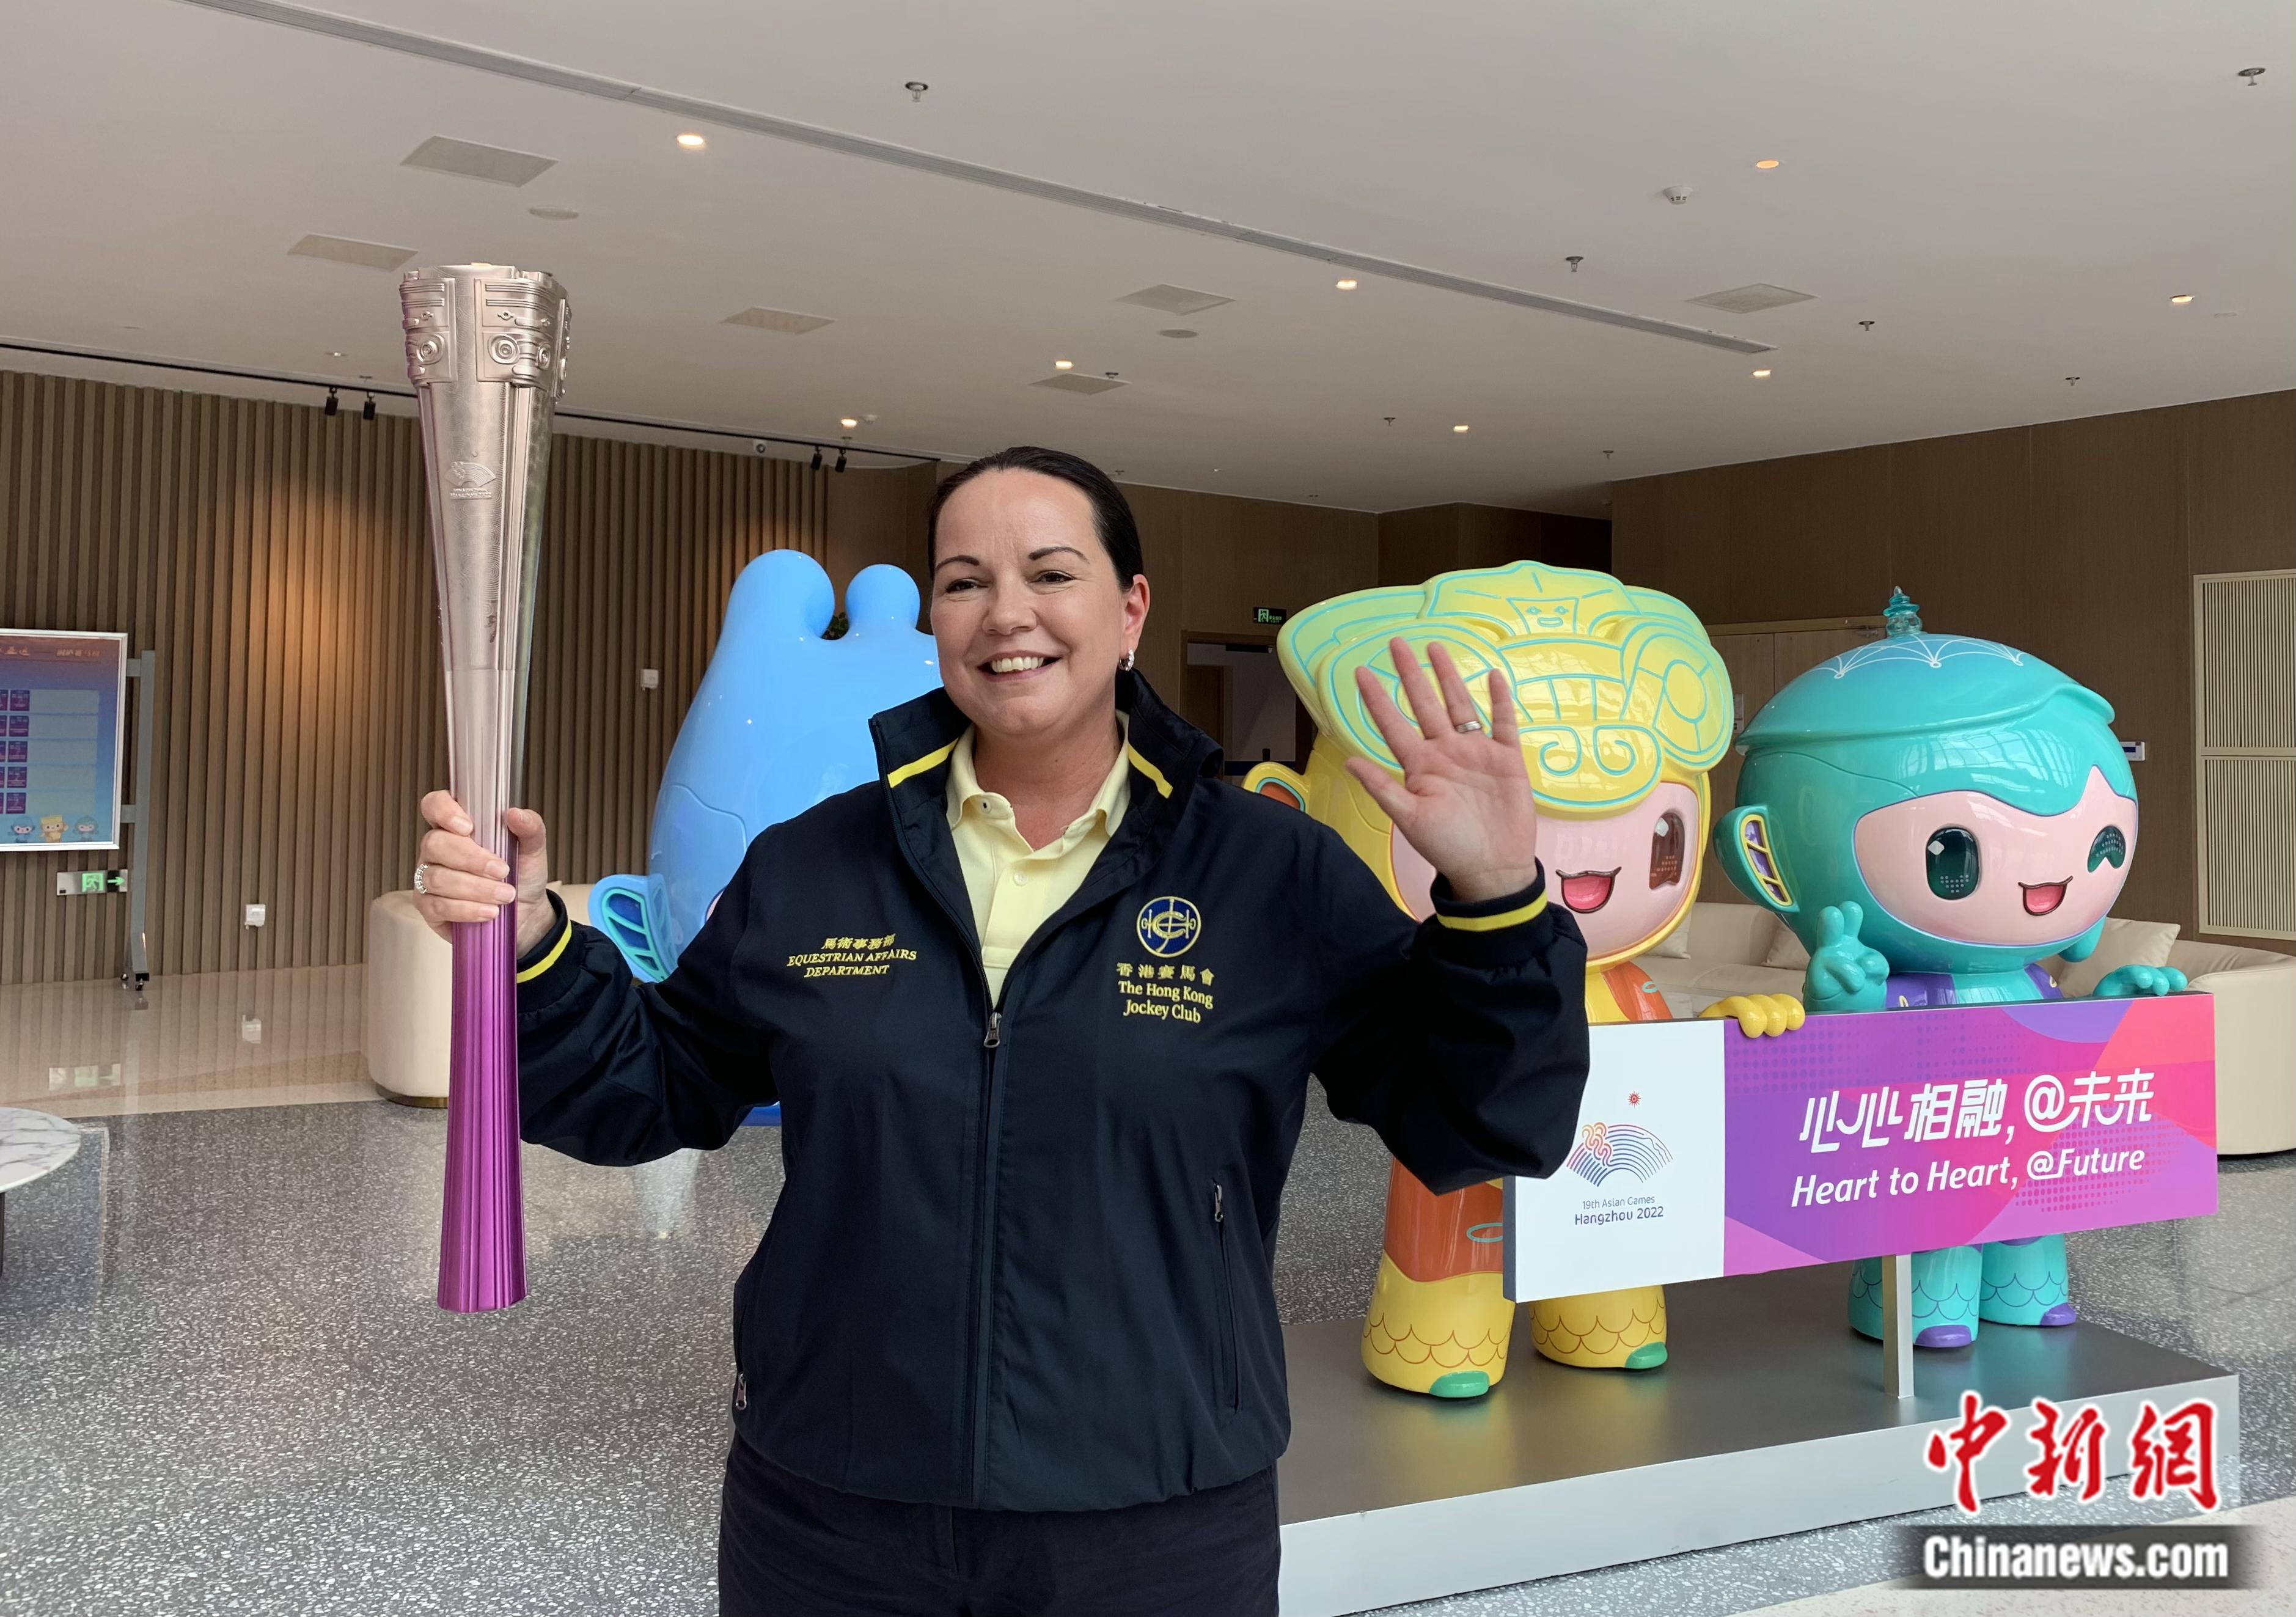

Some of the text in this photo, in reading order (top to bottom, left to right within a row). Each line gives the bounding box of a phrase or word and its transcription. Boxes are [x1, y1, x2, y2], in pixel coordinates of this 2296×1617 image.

[787, 948, 917, 966] EQUESTRIAN AFFAIRS
[804, 964, 890, 978] DEPARTMENT
[1116, 961, 1215, 986] 香港賽馬會
[1118, 980, 1214, 1010] The Hong Kong
[1123, 999, 1201, 1024] Jockey Club
[1791, 1149, 2146, 1208] Heart to Heart, @Future
[1582, 1196, 1656, 1209] 19th Asian Games
[1575, 1206, 1663, 1225] Hangzhou 2022
